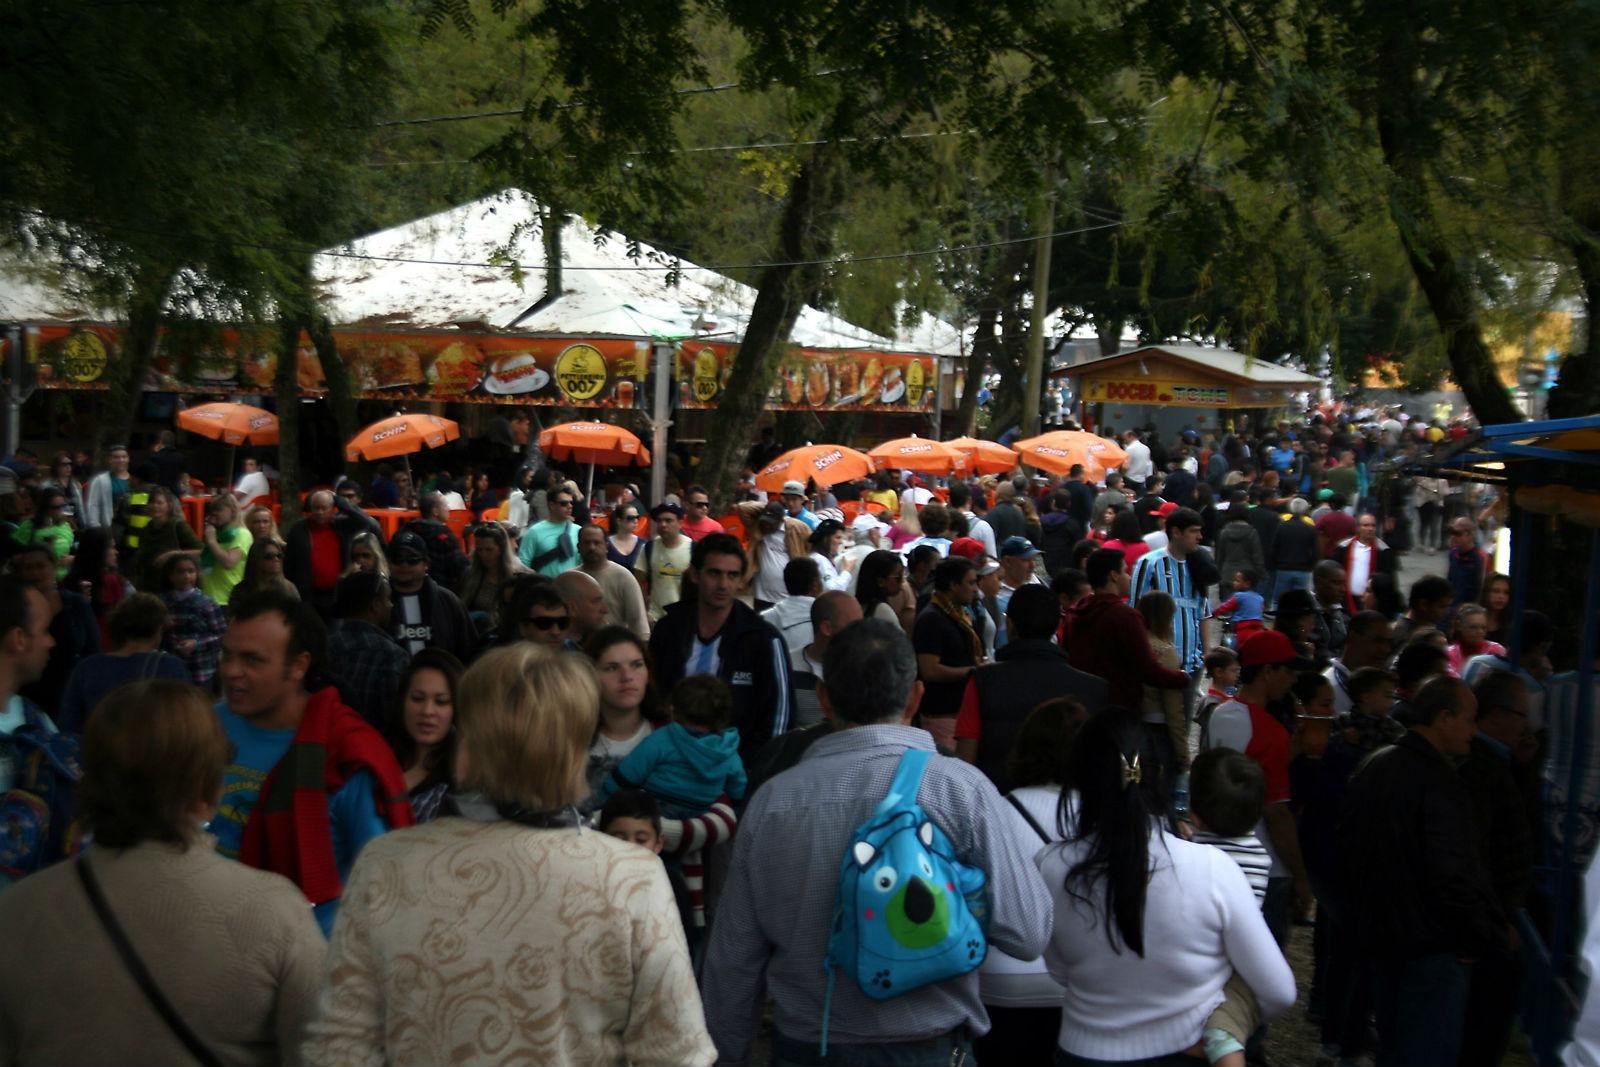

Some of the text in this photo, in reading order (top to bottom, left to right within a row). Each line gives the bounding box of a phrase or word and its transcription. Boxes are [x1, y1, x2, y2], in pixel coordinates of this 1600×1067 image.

[567, 380, 597, 393] 007
[1106, 382, 1157, 400] DOCES
[372, 424, 408, 442] SCHIN
[900, 444, 933, 455] SCHIN
[1035, 446, 1068, 458] SCHIN
[815, 449, 843, 470] SCHIN
